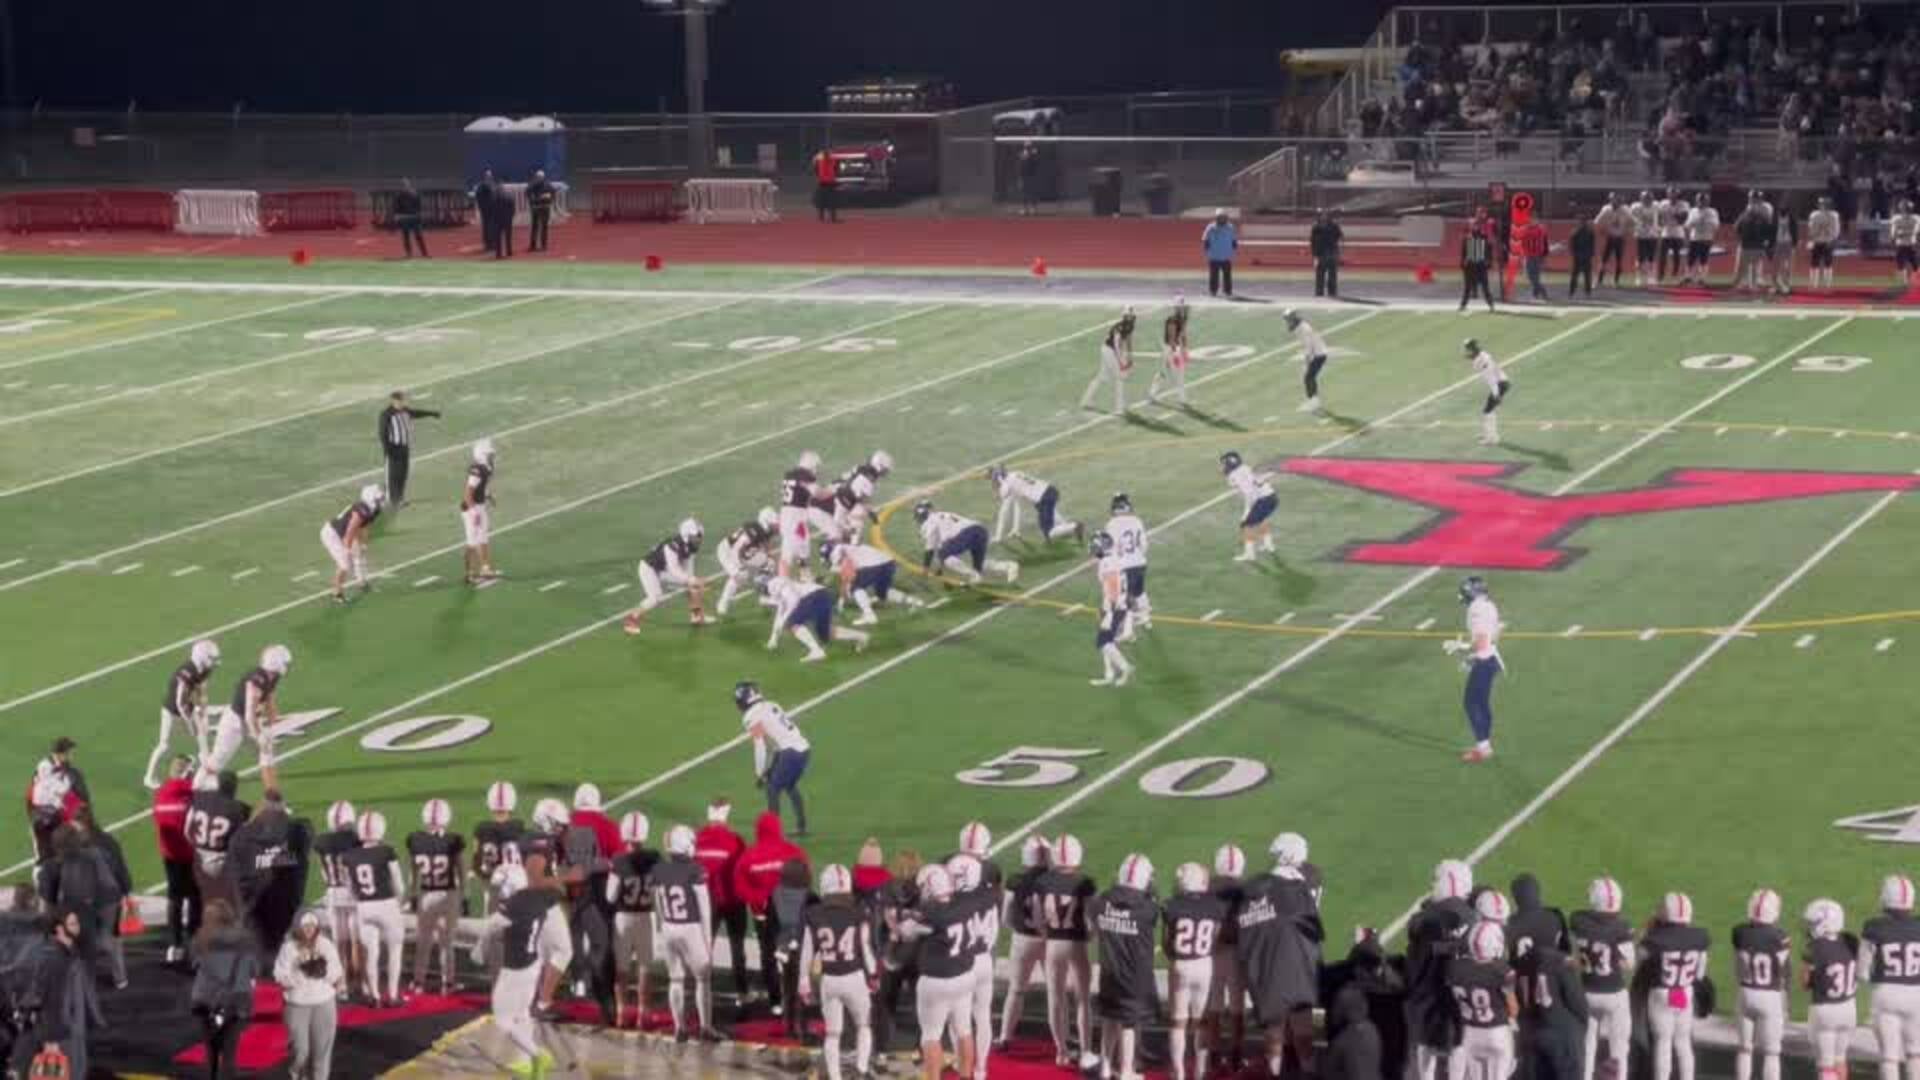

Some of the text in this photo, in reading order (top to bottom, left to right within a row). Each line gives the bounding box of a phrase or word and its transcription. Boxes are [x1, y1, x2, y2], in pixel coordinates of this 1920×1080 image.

[1282, 457, 1920, 571] Y
[194, 810, 231, 848] 32
[356, 863, 376, 896] 9
[814, 926, 857, 961] 24
[1175, 917, 1215, 956] 28
[1662, 950, 1699, 986] 52
